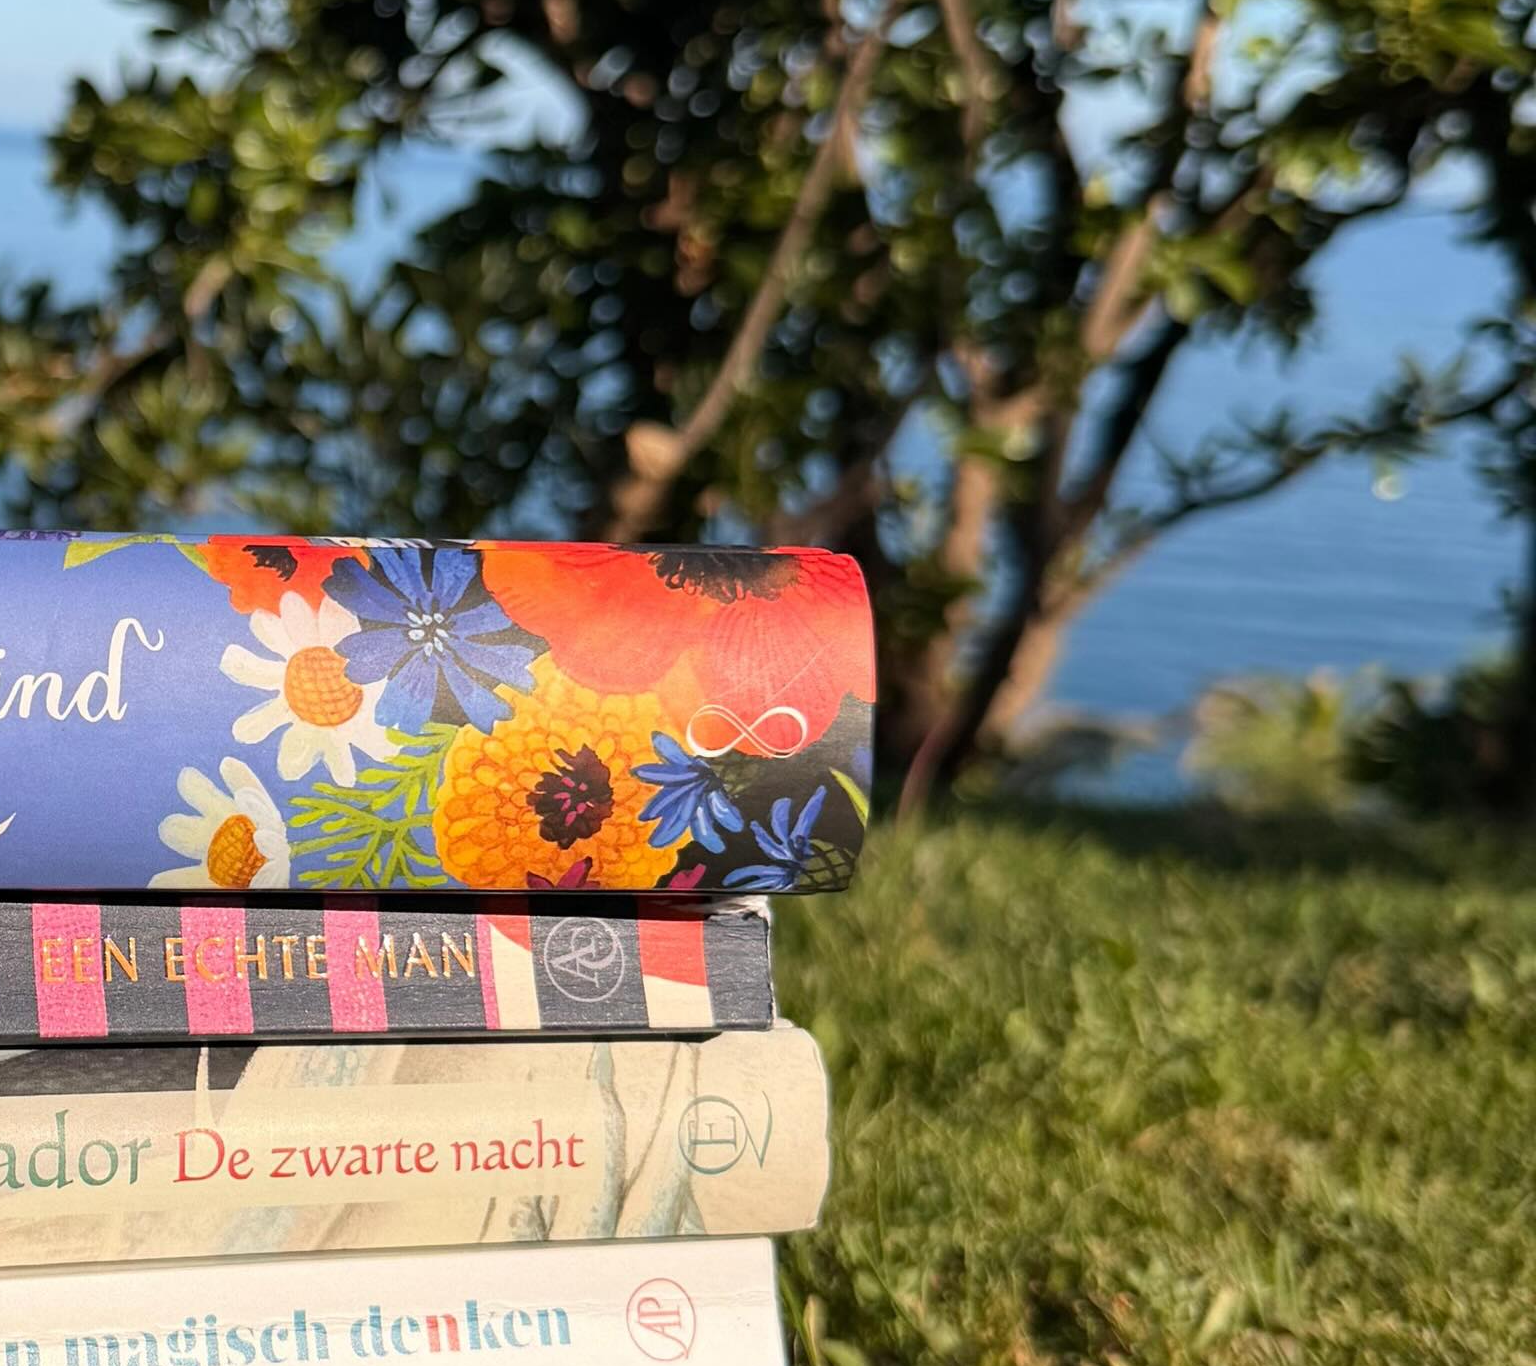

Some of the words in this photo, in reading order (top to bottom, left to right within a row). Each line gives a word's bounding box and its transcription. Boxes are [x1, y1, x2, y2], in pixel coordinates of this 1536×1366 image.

[41, 936, 141, 984] EEN
[165, 933, 328, 984] ECHTE
[355, 931, 475, 980] MAN
[173, 1128, 254, 1184] De
[269, 1136, 439, 1179] zwarte
[451, 1119, 586, 1173] nacht
[350, 1299, 572, 1358] denken
